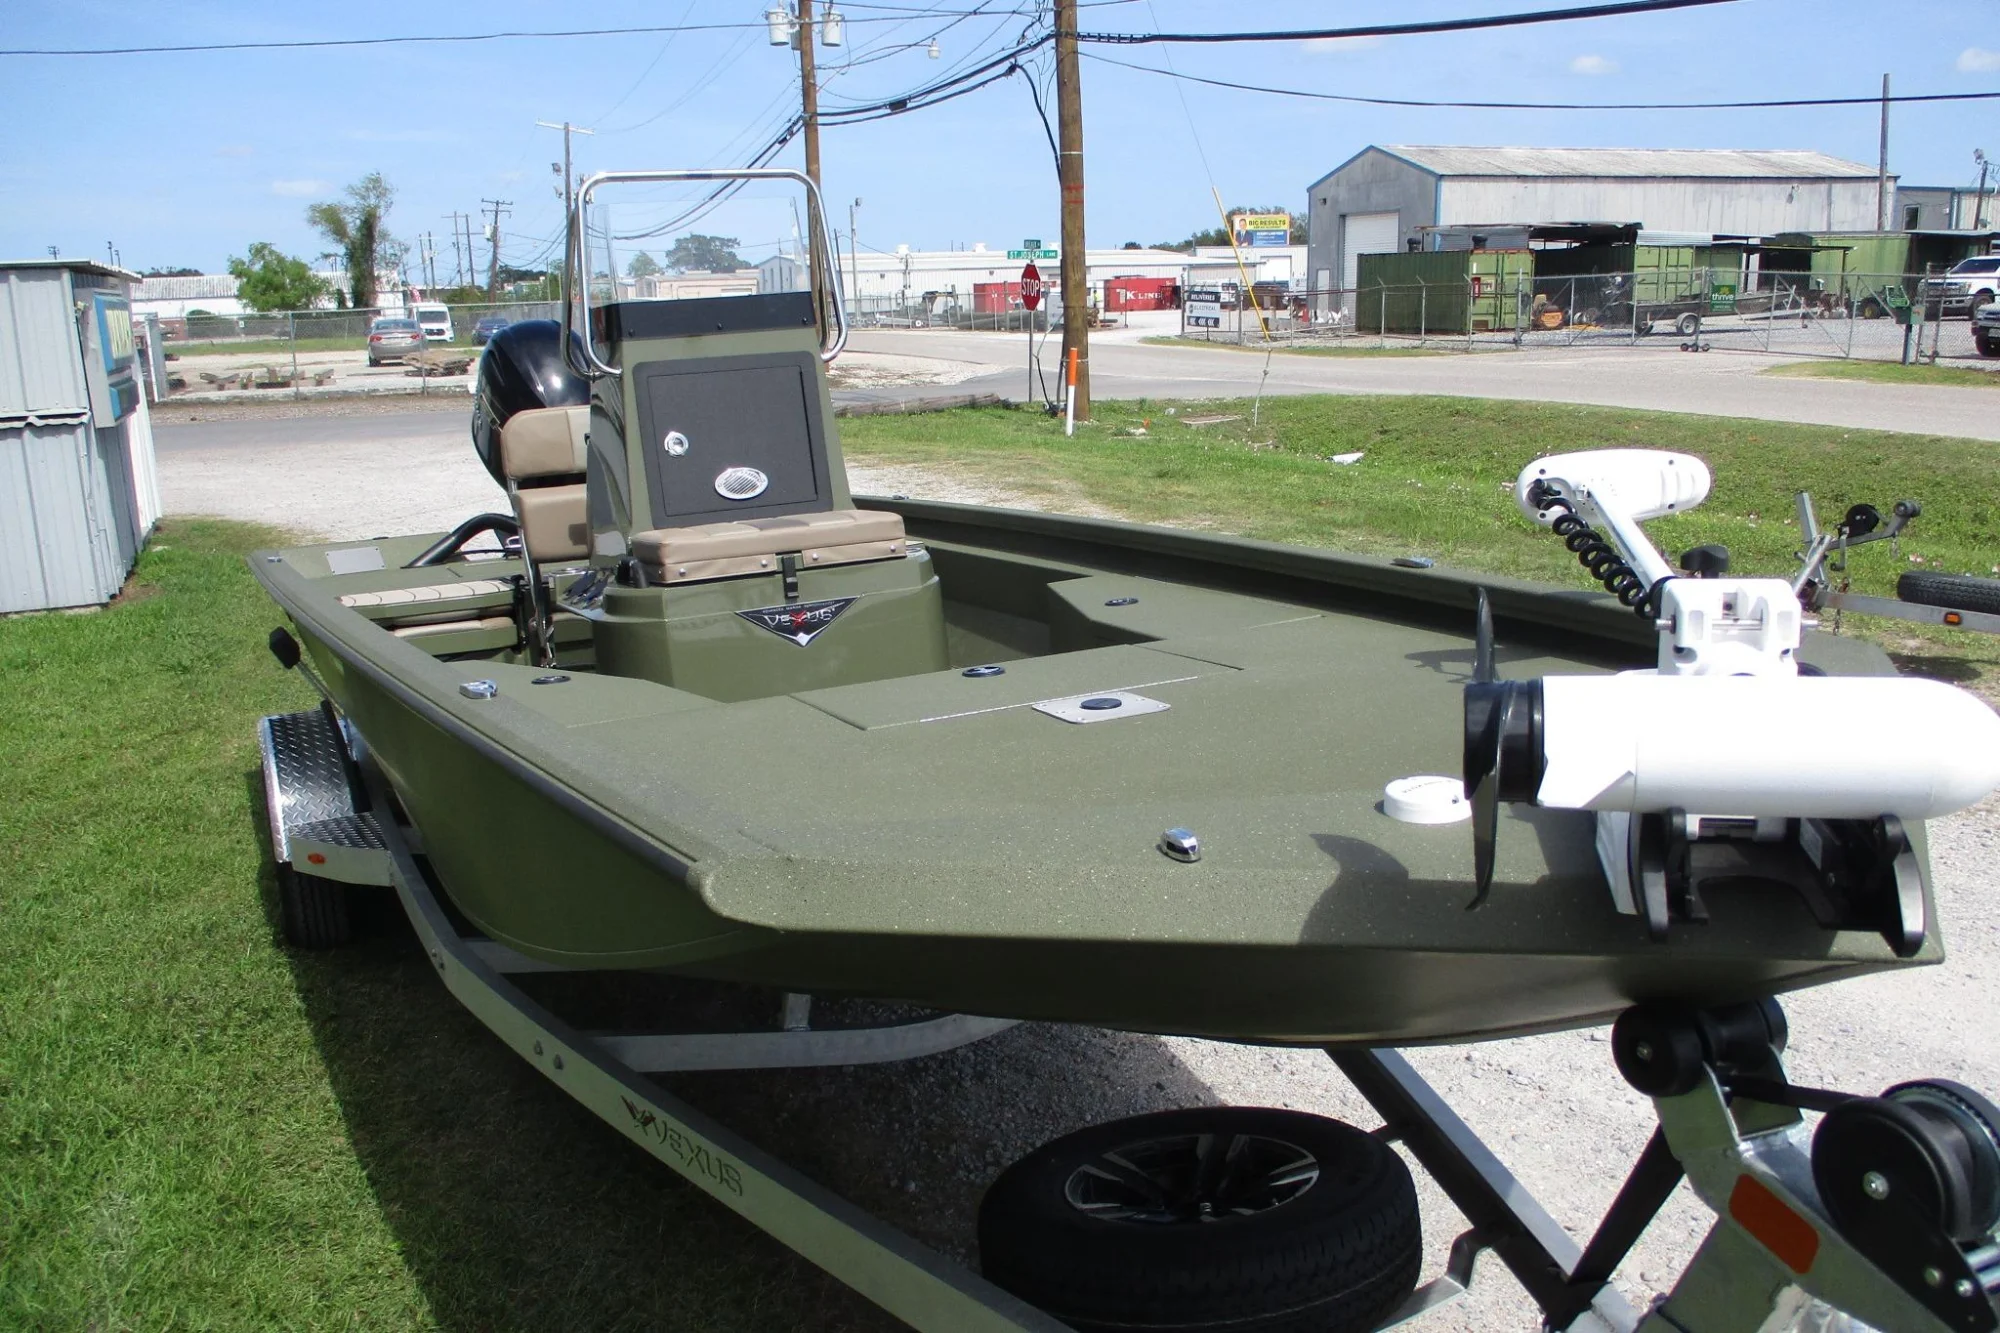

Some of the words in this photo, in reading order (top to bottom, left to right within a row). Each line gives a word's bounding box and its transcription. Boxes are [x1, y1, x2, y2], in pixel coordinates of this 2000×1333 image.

[1022, 278, 1040, 297] STOP
[1711, 293, 1735, 301] thrive
[762, 606, 838, 629] VEXUS
